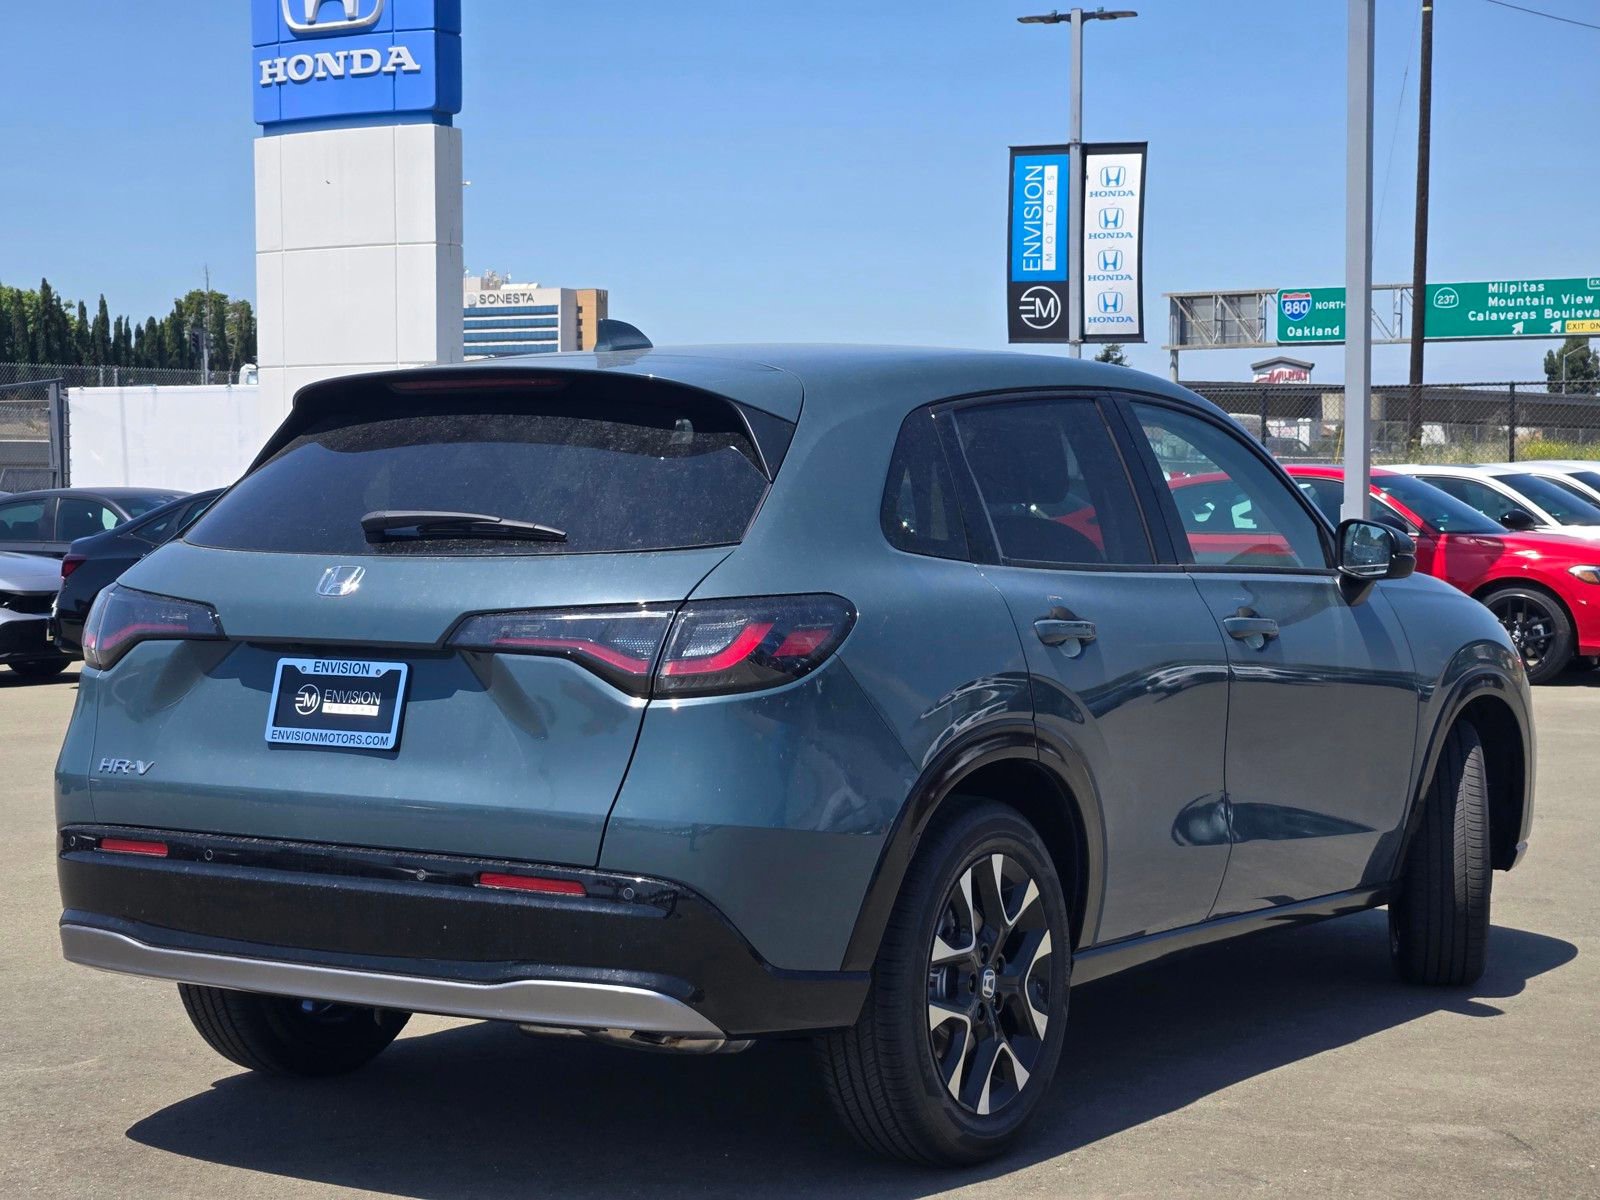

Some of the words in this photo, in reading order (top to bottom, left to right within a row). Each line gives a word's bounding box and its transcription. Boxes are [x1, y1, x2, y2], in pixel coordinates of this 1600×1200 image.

[260, 46, 421, 85] HONDA
[1089, 189, 1135, 198] HONDA
[1023, 165, 1043, 271] ENVISION
[1045, 175, 1055, 262] MOTORS
[1088, 231, 1134, 240] HONDA
[1087, 274, 1134, 282] HONDA
[1488, 282, 1545, 295] Milpitas
[479, 293, 535, 305] SONESTA
[1437, 295, 1455, 305] 237
[1488, 295, 1554, 307] Mountain
[1561, 293, 1594, 305] View
[1284, 301, 1309, 315] 880
[1087, 316, 1135, 324] HONDA
[1468, 310, 1537, 322] Calaveras
[1286, 325, 1340, 337] Oakland
[1566, 322, 1585, 330] EXIT
[313, 661, 370, 675] ENVISION
[323, 689, 381, 705] ENVISION
[271, 729, 389, 747] ENVISIONMOTORS.COM
[98, 758, 155, 776] HR-V
